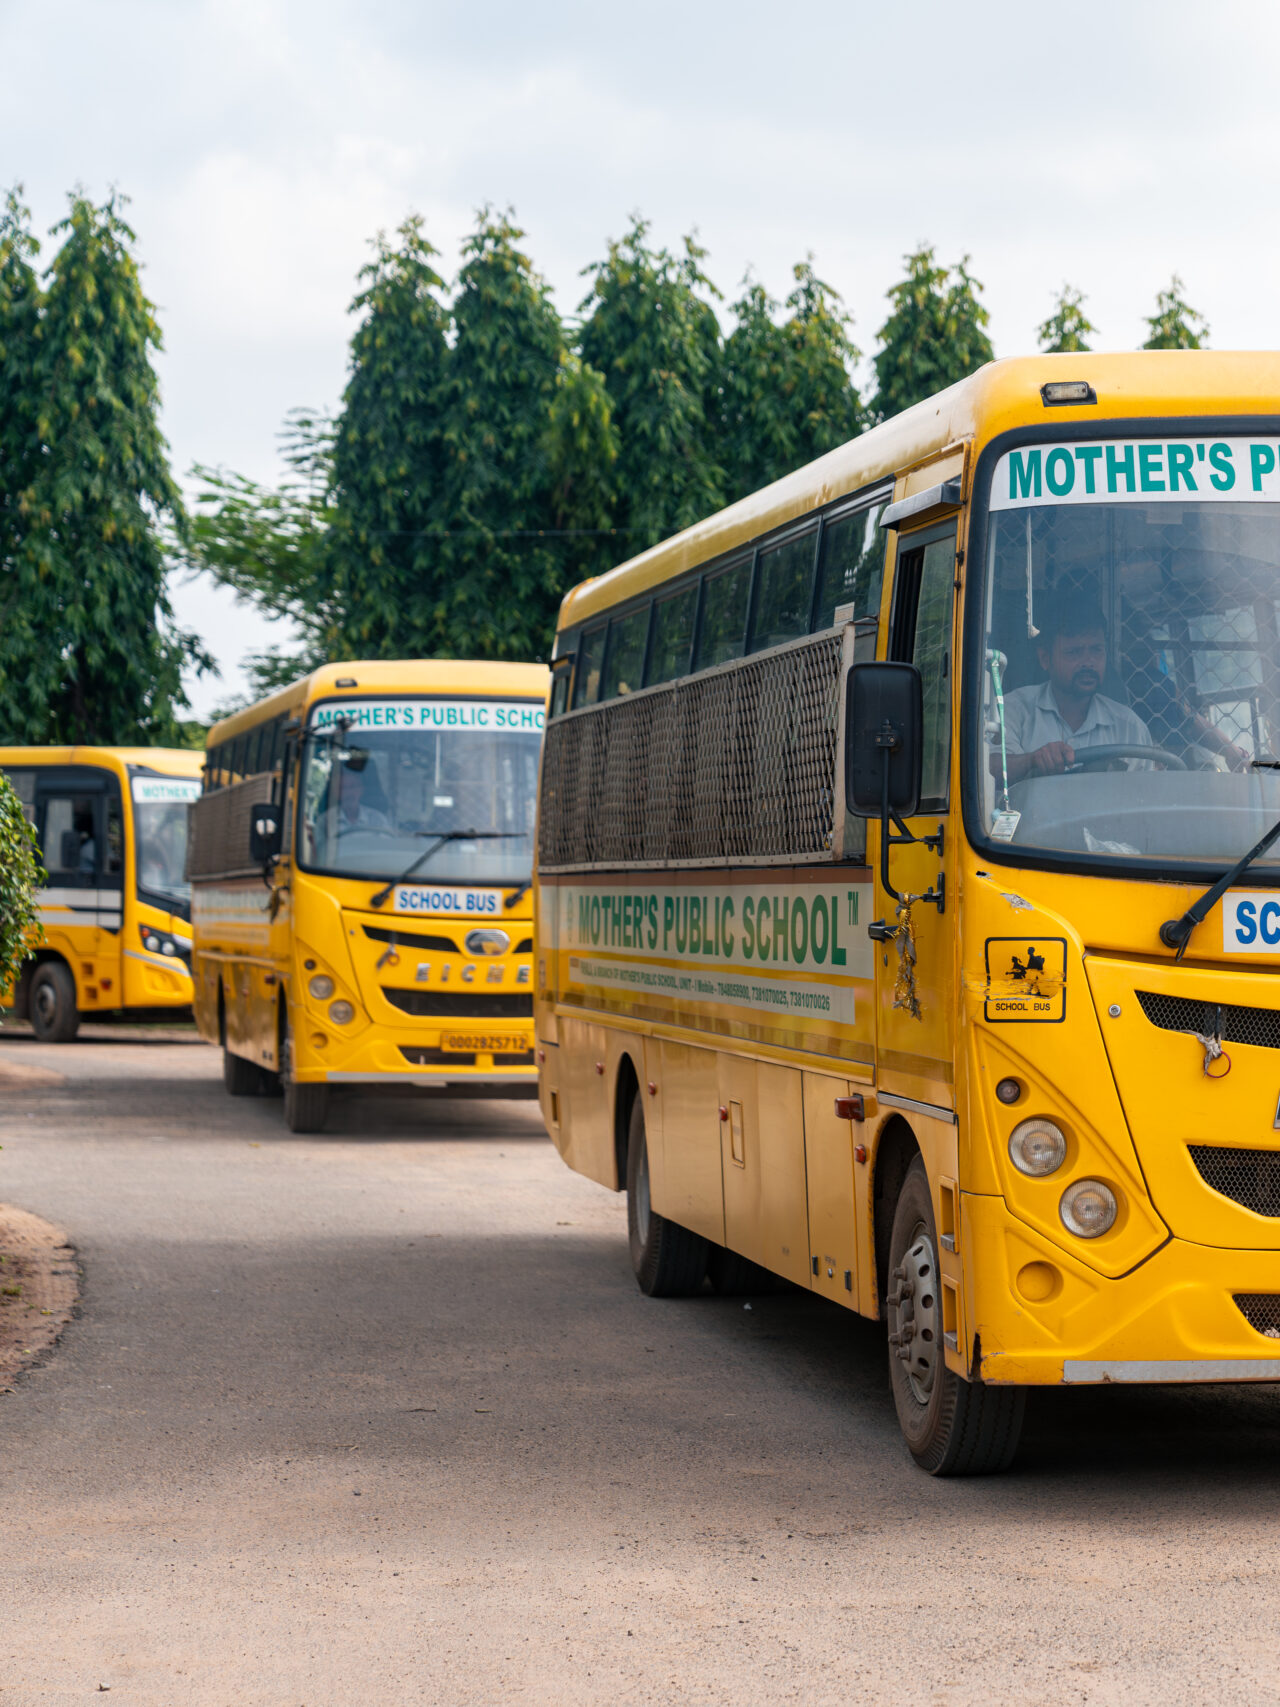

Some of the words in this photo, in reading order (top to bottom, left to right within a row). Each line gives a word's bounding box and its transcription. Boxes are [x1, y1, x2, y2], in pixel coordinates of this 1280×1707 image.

[1008, 442, 1236, 500] MOTHER'S
[420, 707, 489, 725] PUBLIC
[399, 891, 461, 910] SCHOOL
[466, 893, 496, 912] BUS
[578, 894, 659, 950] MOTHER'S
[664, 895, 735, 958] PUBLIC
[790, 992, 830, 1011] 7381070026
[995, 1003, 1028, 1011] SCHOOL
[1034, 1003, 1051, 1011] BUS
